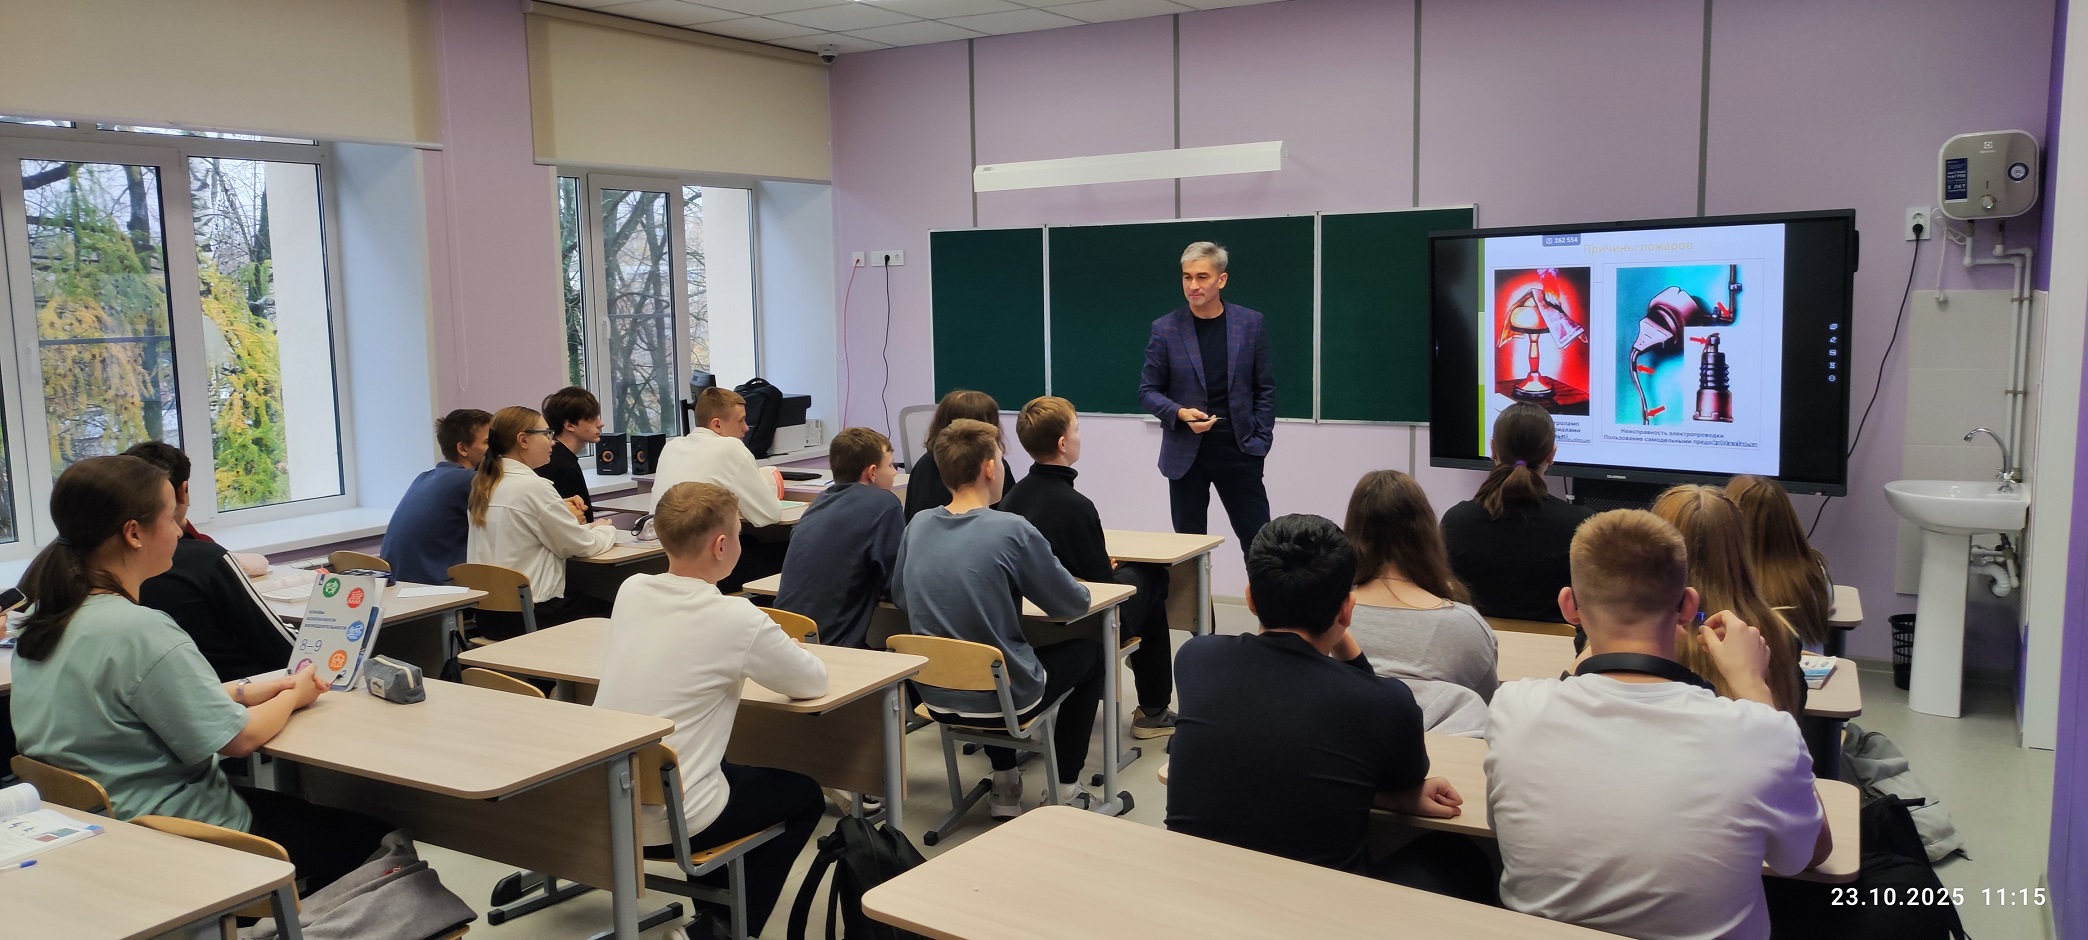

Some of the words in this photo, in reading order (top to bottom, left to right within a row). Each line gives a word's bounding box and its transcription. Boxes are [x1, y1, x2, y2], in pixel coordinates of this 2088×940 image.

[1584, 244, 1637, 254] Причины
[1641, 242, 1693, 251] пожаров
[1620, 428, 1667, 436] Неисправность
